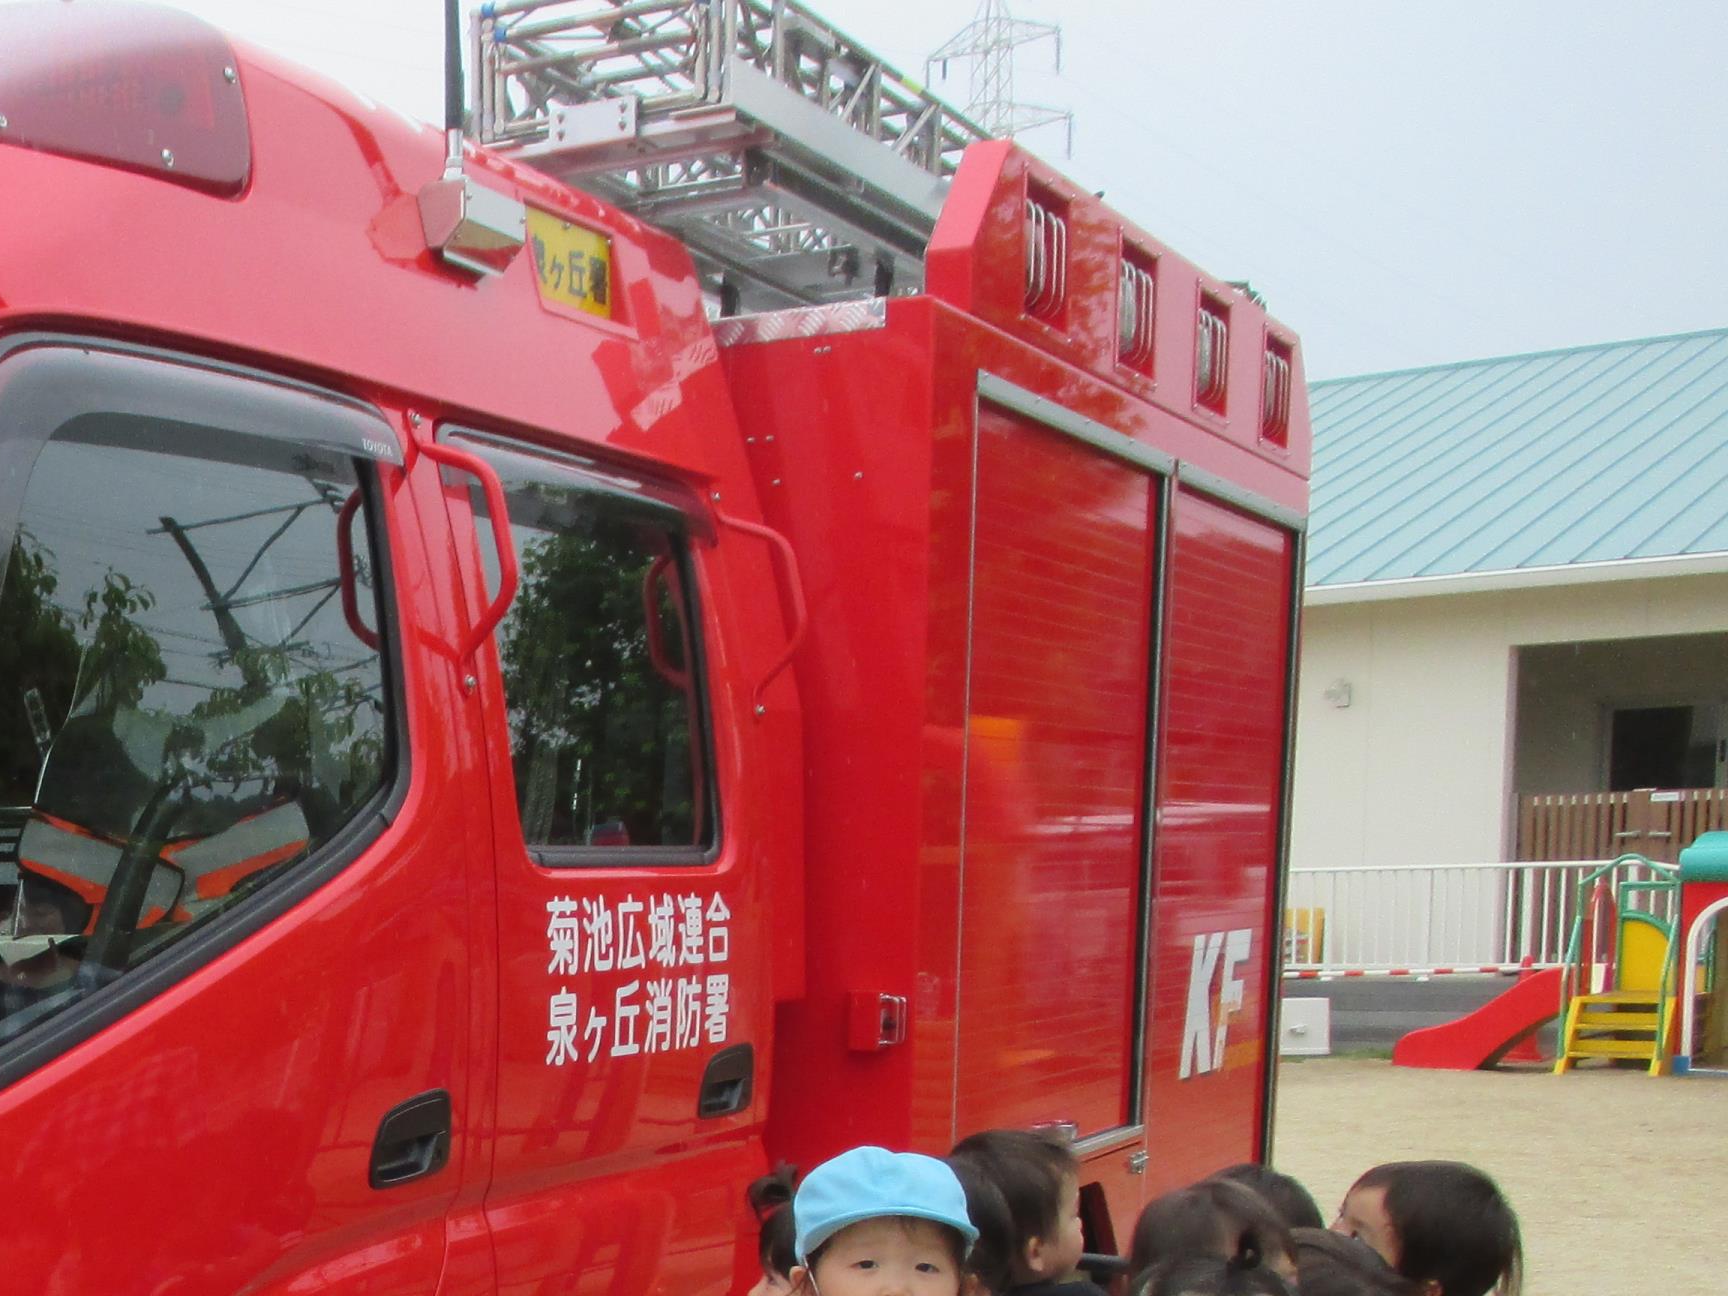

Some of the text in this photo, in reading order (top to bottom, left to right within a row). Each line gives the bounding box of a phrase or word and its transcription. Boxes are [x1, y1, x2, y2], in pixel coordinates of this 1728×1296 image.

[546, 891, 731, 975] 菊池広域連合
[1179, 928, 1252, 1080] KF
